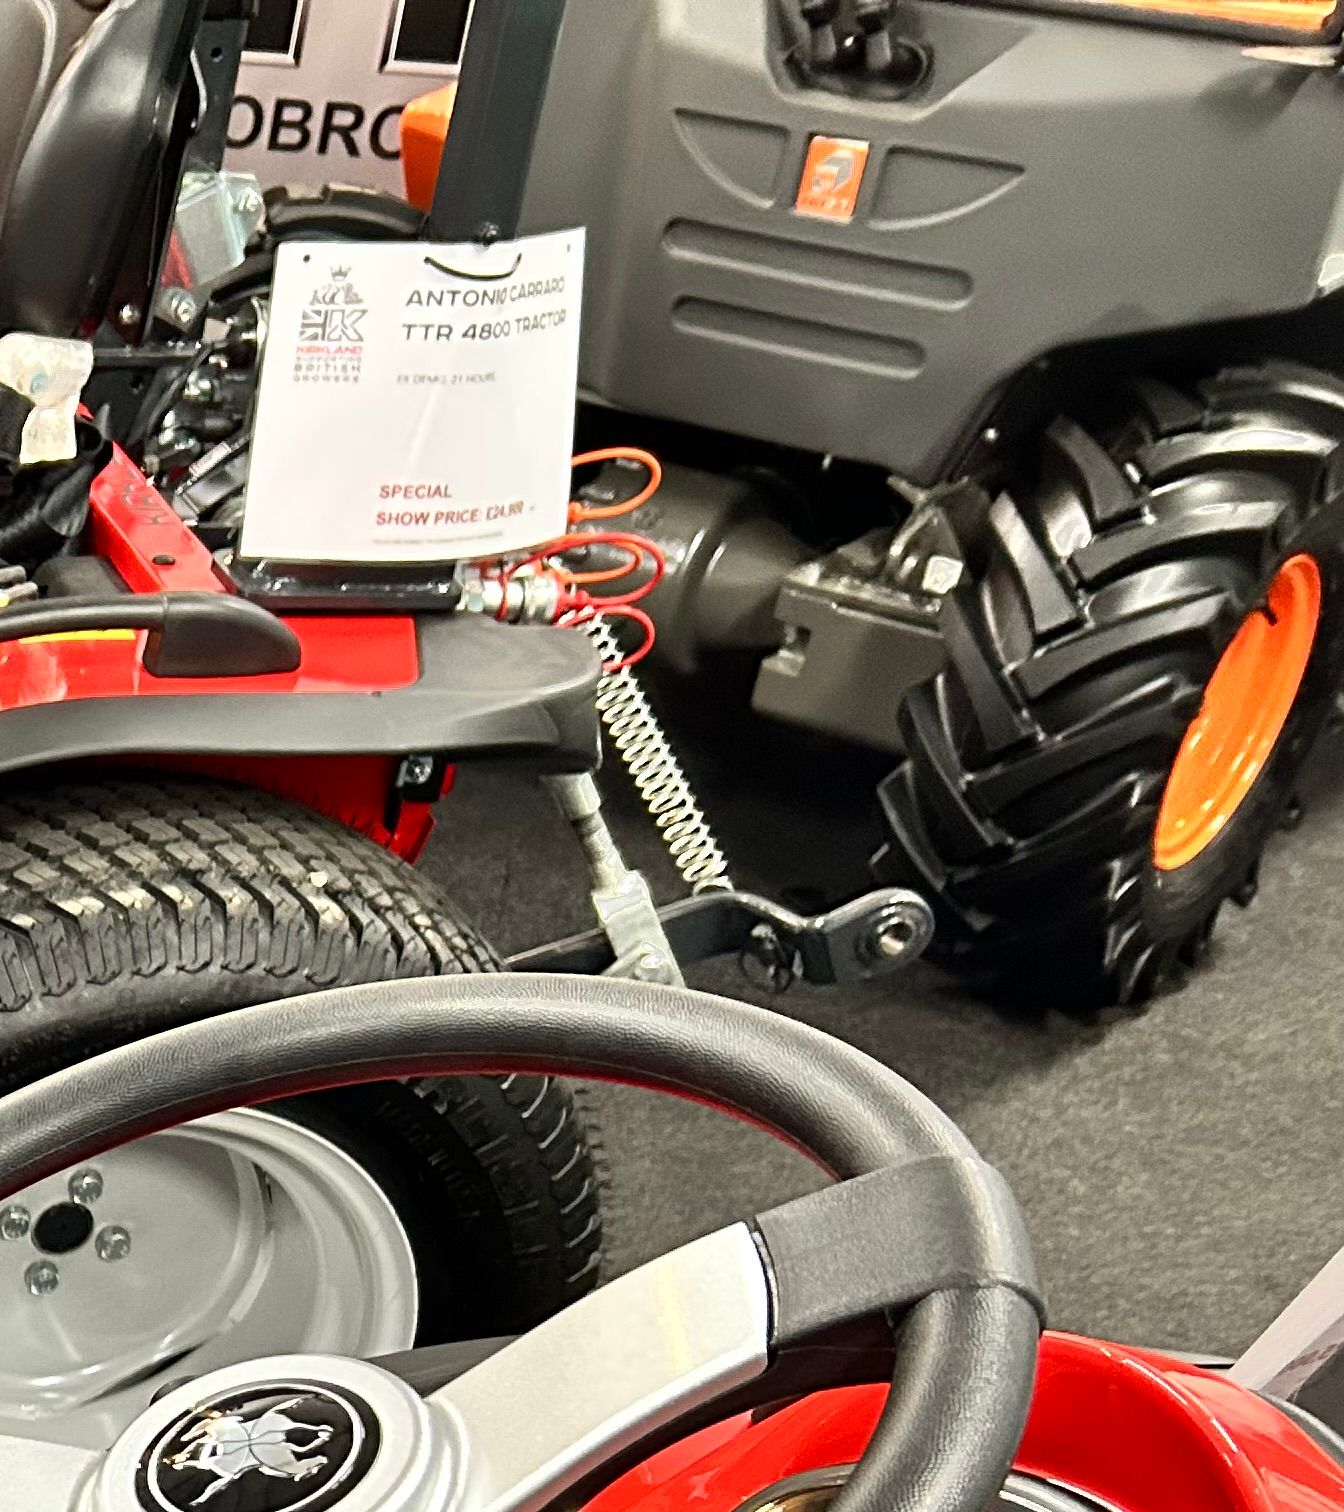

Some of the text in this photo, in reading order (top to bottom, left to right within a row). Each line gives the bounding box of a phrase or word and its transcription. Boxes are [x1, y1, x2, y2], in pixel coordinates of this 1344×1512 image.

[405, 289, 507, 307] ANTONIO
[402, 323, 453, 341] TTR
[462, 320, 510, 341] 4800
[379, 484, 453, 500] SPECIAL
[375, 511, 430, 527] SHOW
